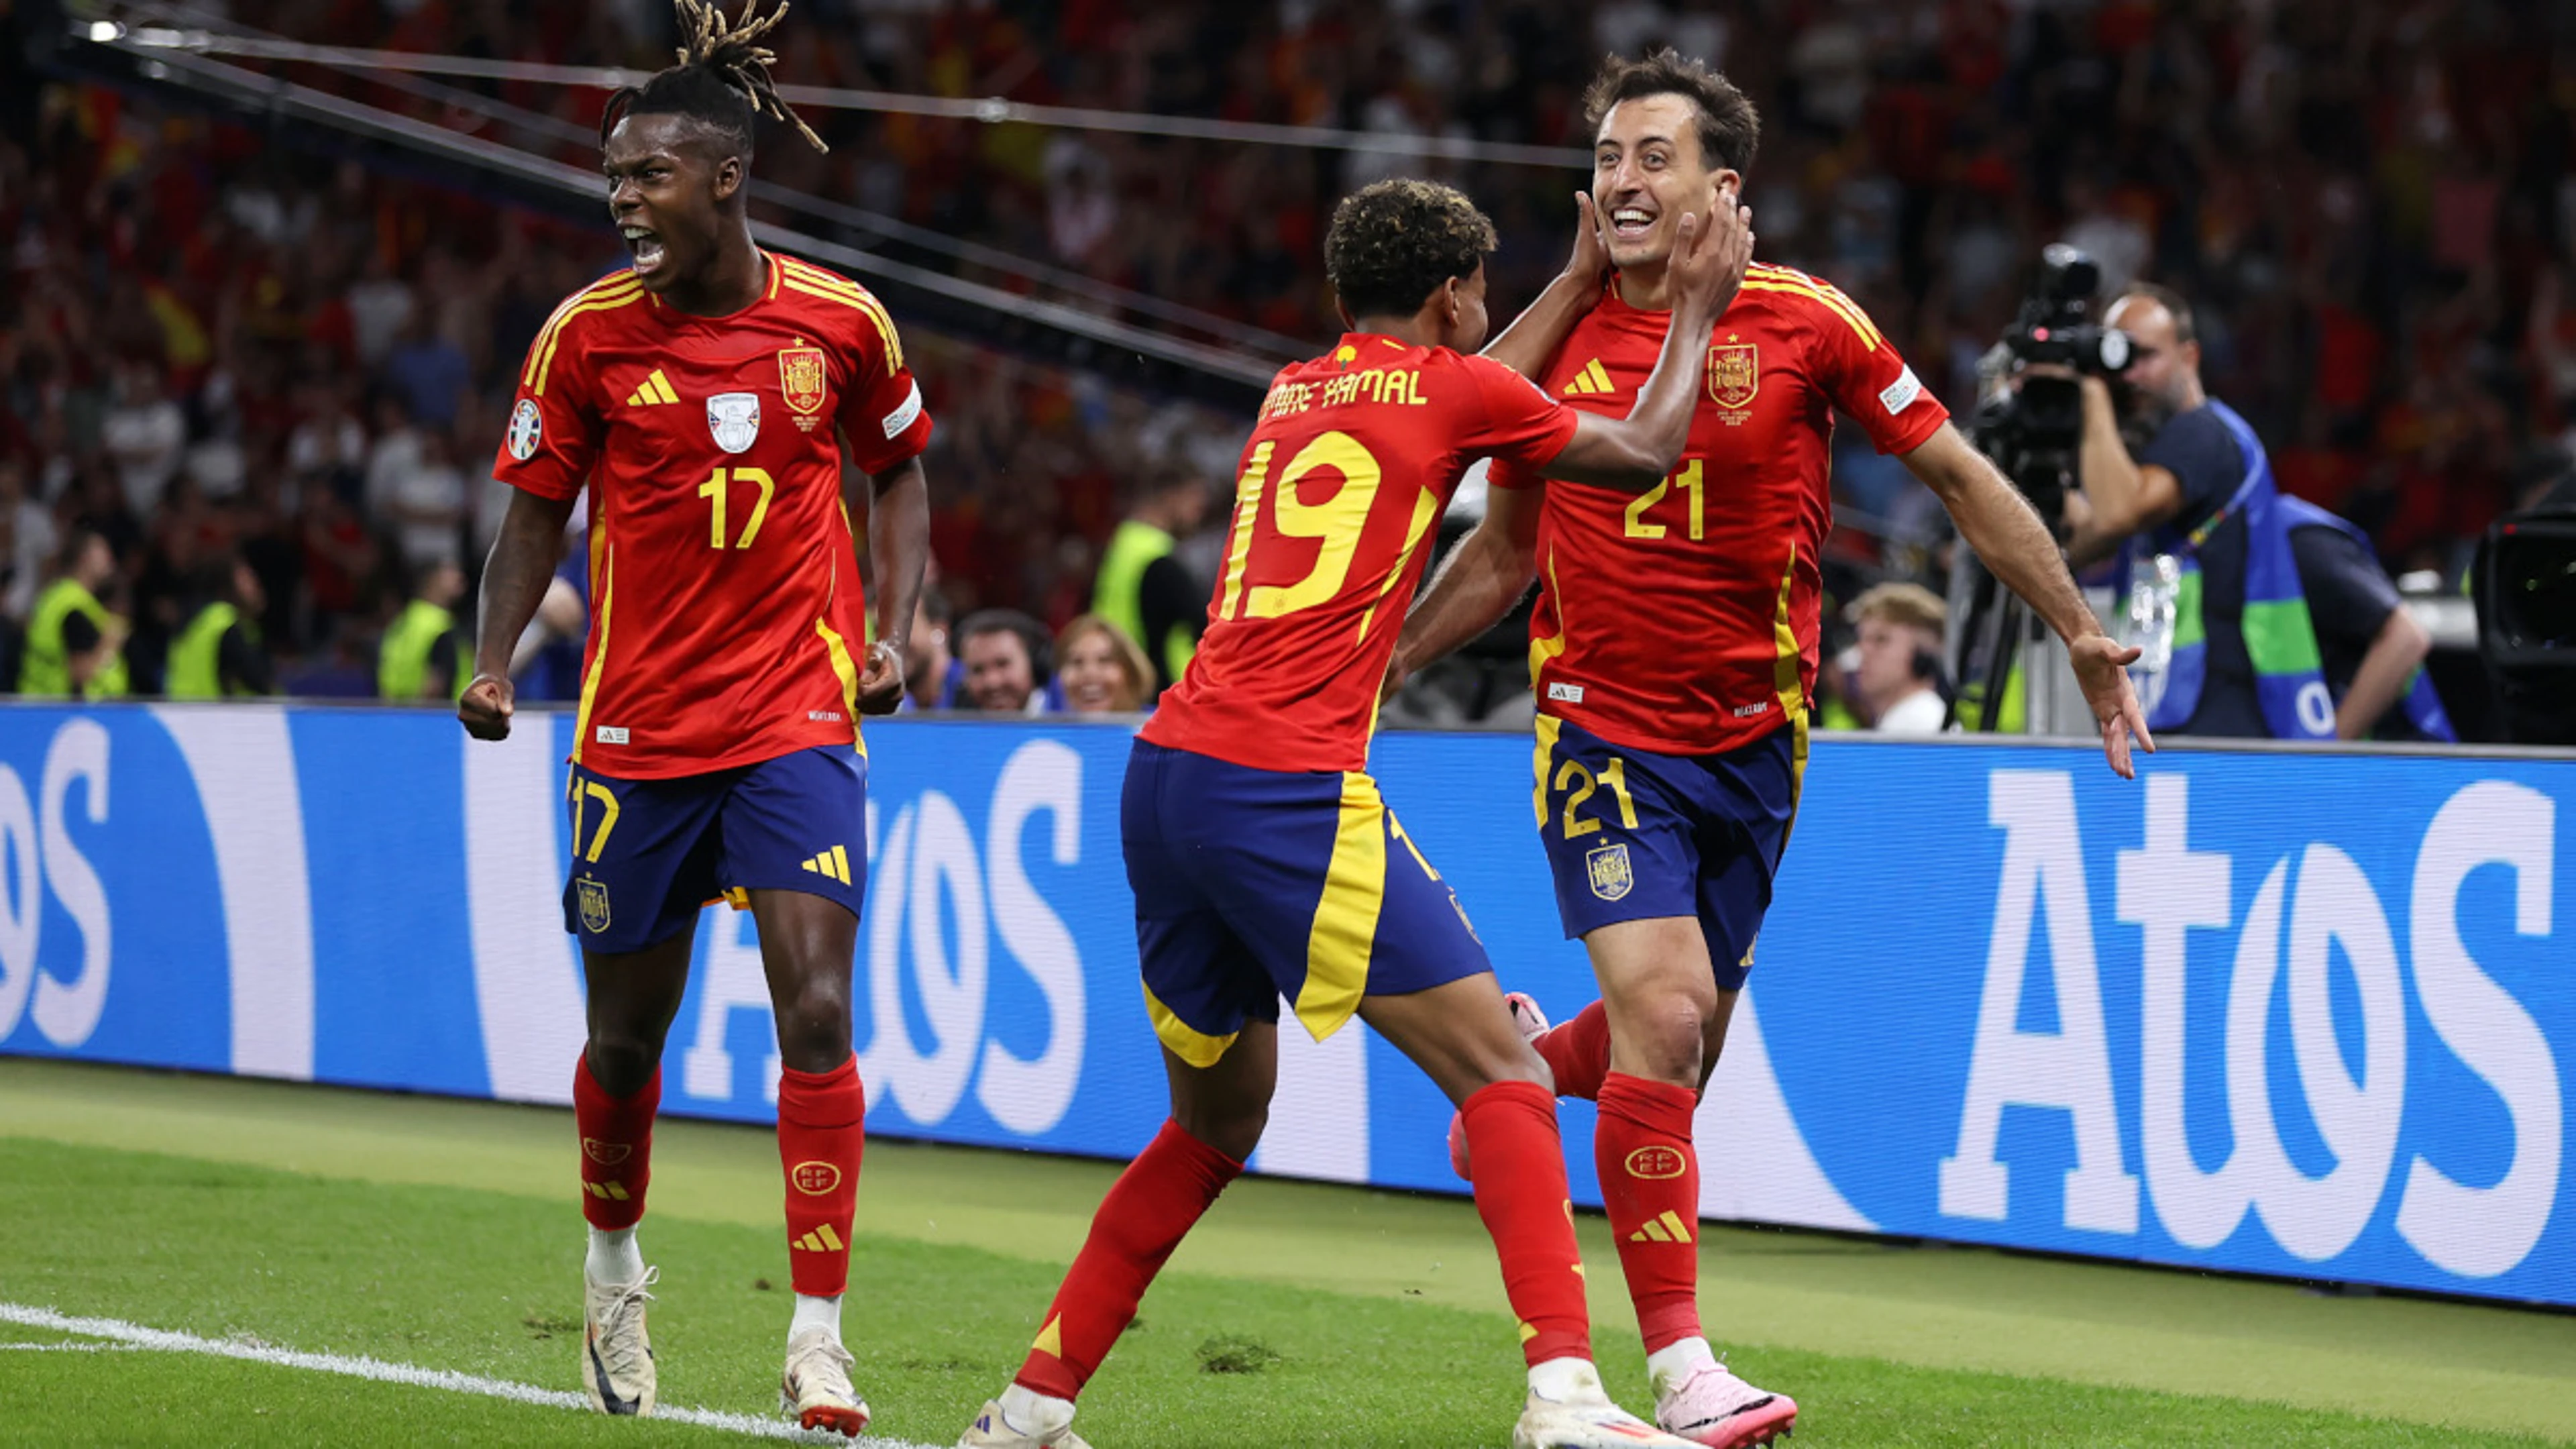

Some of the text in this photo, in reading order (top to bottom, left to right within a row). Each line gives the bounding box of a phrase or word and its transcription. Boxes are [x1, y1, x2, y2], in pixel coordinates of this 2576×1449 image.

[698, 468, 775, 549] 17
[1219, 431, 1381, 621] 19
[1624, 459, 1704, 540] 21
[572, 775, 620, 863] 17
[1554, 757, 1639, 839] 21
